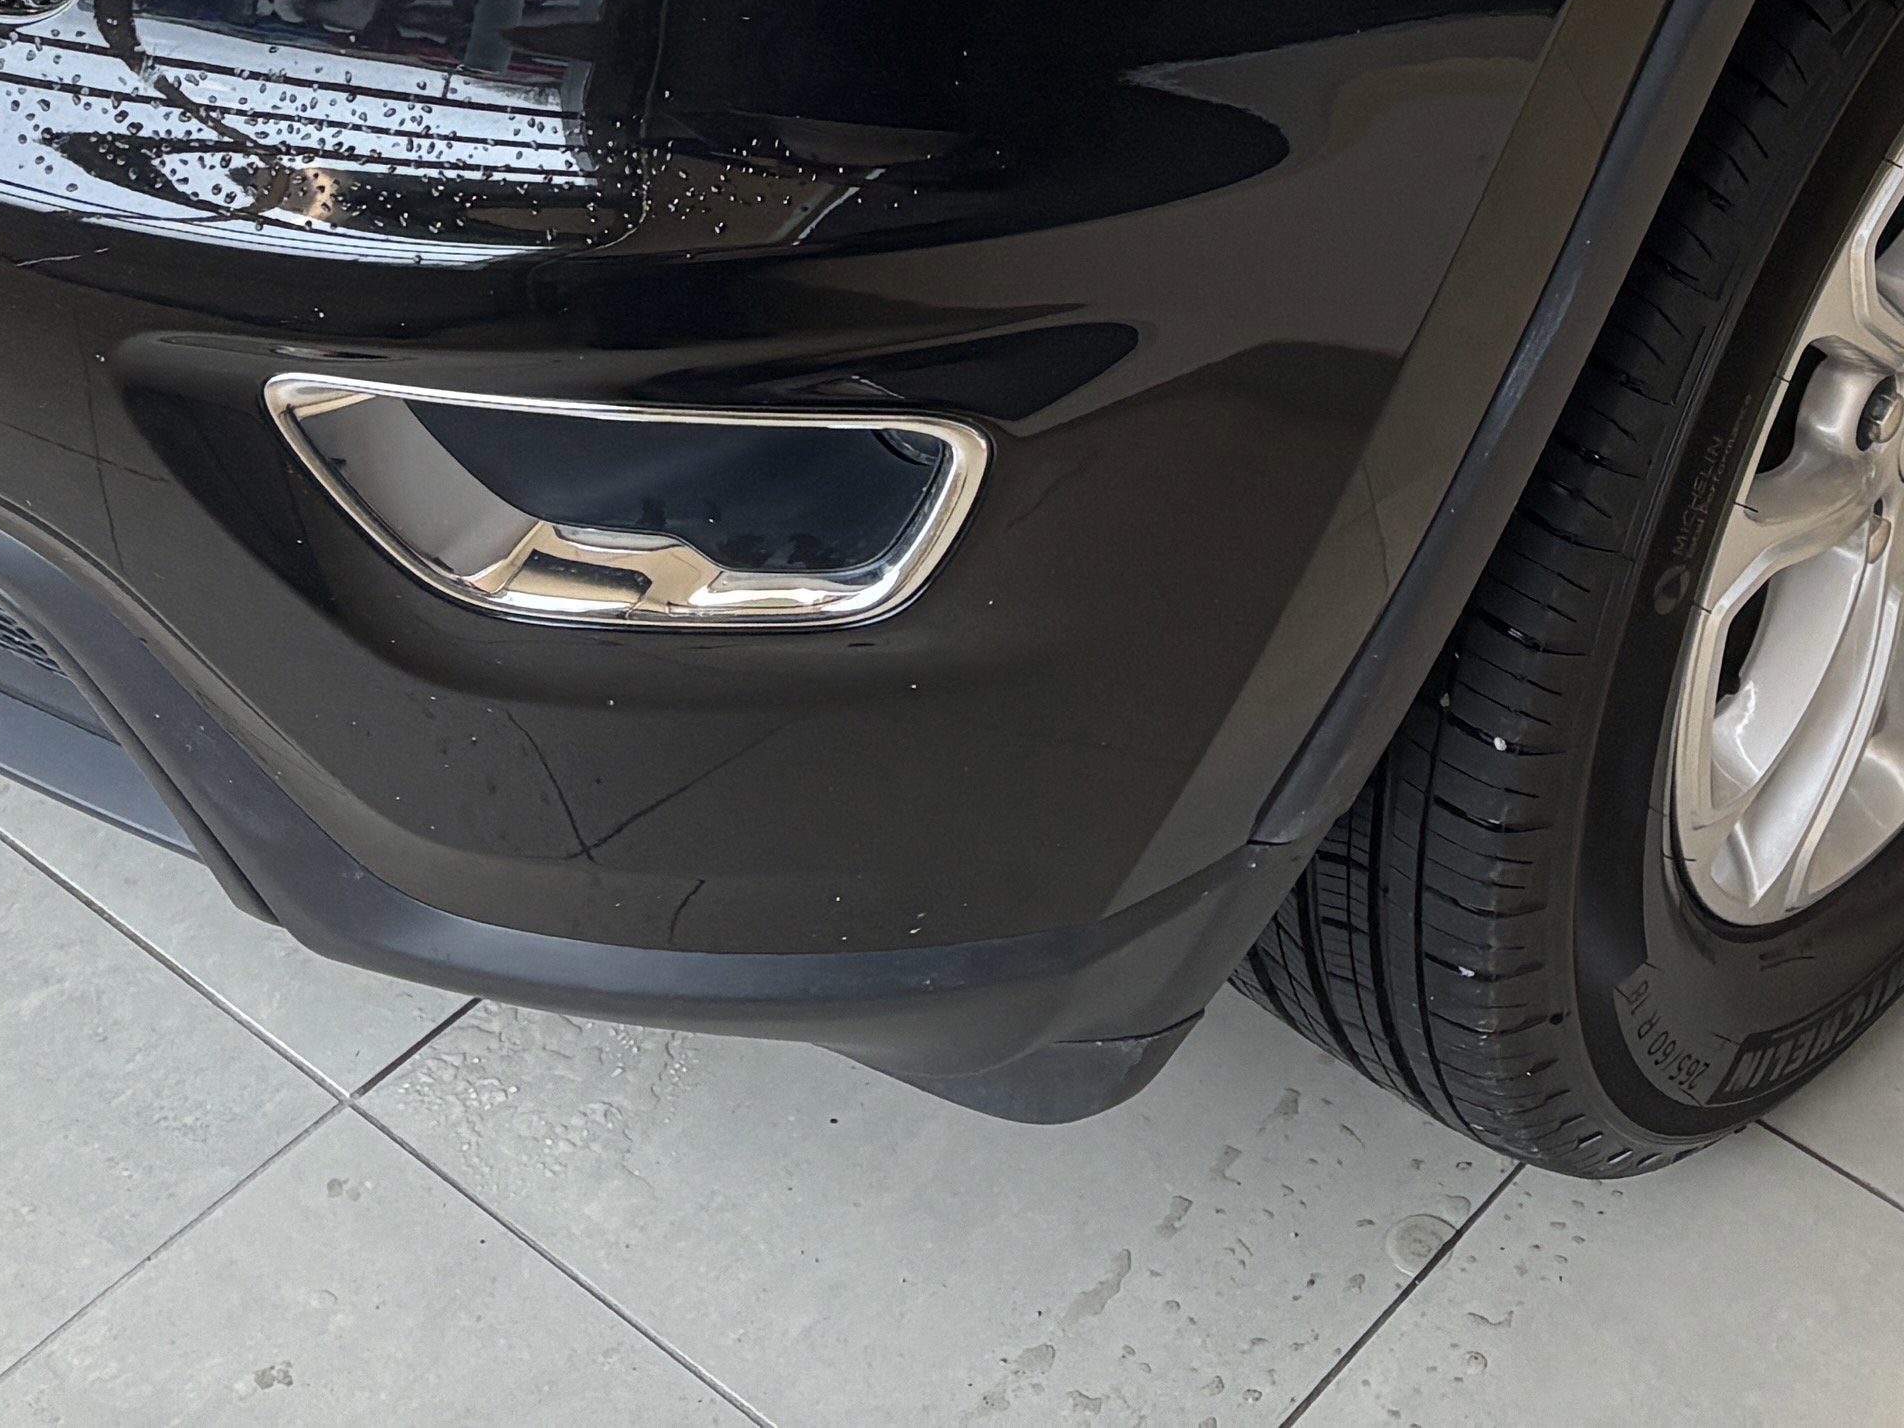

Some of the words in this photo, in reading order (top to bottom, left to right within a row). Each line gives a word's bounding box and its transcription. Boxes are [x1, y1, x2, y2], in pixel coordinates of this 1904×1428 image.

[1671, 435, 1725, 557] MICHELIN
[1629, 980, 1651, 1015] 18
[1637, 1010, 1663, 1039] R
[1648, 1031, 1711, 1090] 265/60
